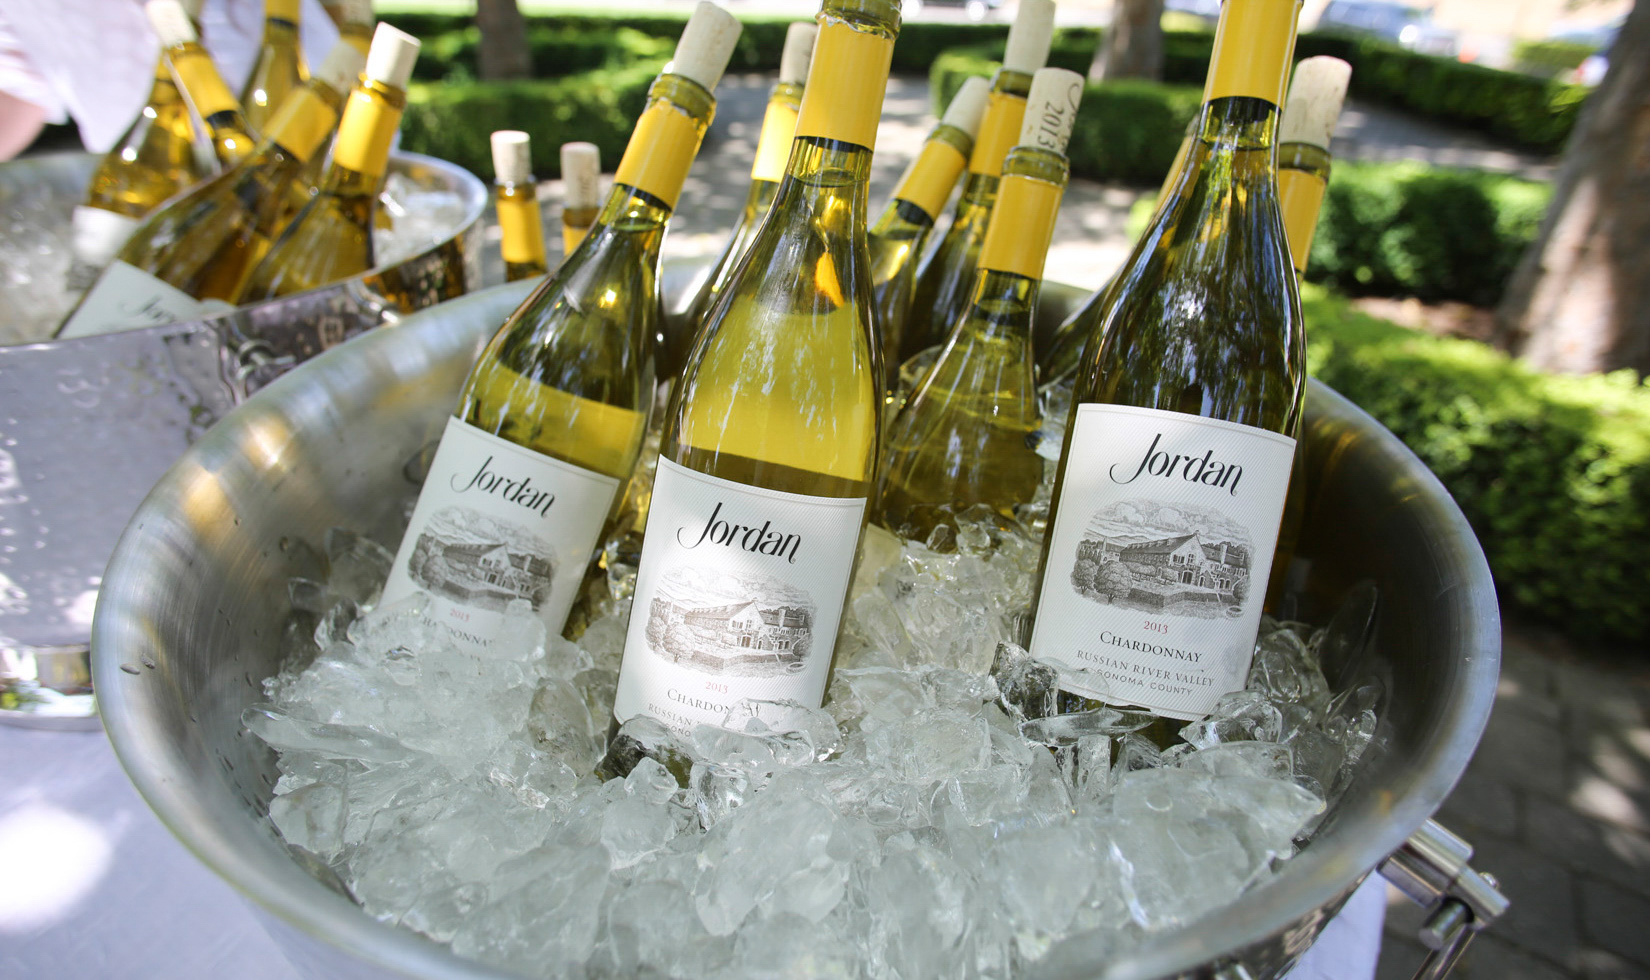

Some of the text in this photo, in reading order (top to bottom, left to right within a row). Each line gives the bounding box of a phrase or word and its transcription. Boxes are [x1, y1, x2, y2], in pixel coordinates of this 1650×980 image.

[1037, 101, 1064, 149] 2013
[1109, 433, 1243, 497] Jordan
[450, 456, 555, 518] Jordan
[677, 502, 801, 564] Jordan
[450, 608, 470, 622] 2013
[1143, 620, 1169, 635] 2013
[1100, 631, 1203, 663] CHARDONNAY
[1077, 650, 1216, 688] RUSSIAN RIVER VALLEY
[705, 681, 729, 695] 2013
[1150, 682, 1193, 697] COUNTY
[648, 703, 693, 726] RUSSIAN
